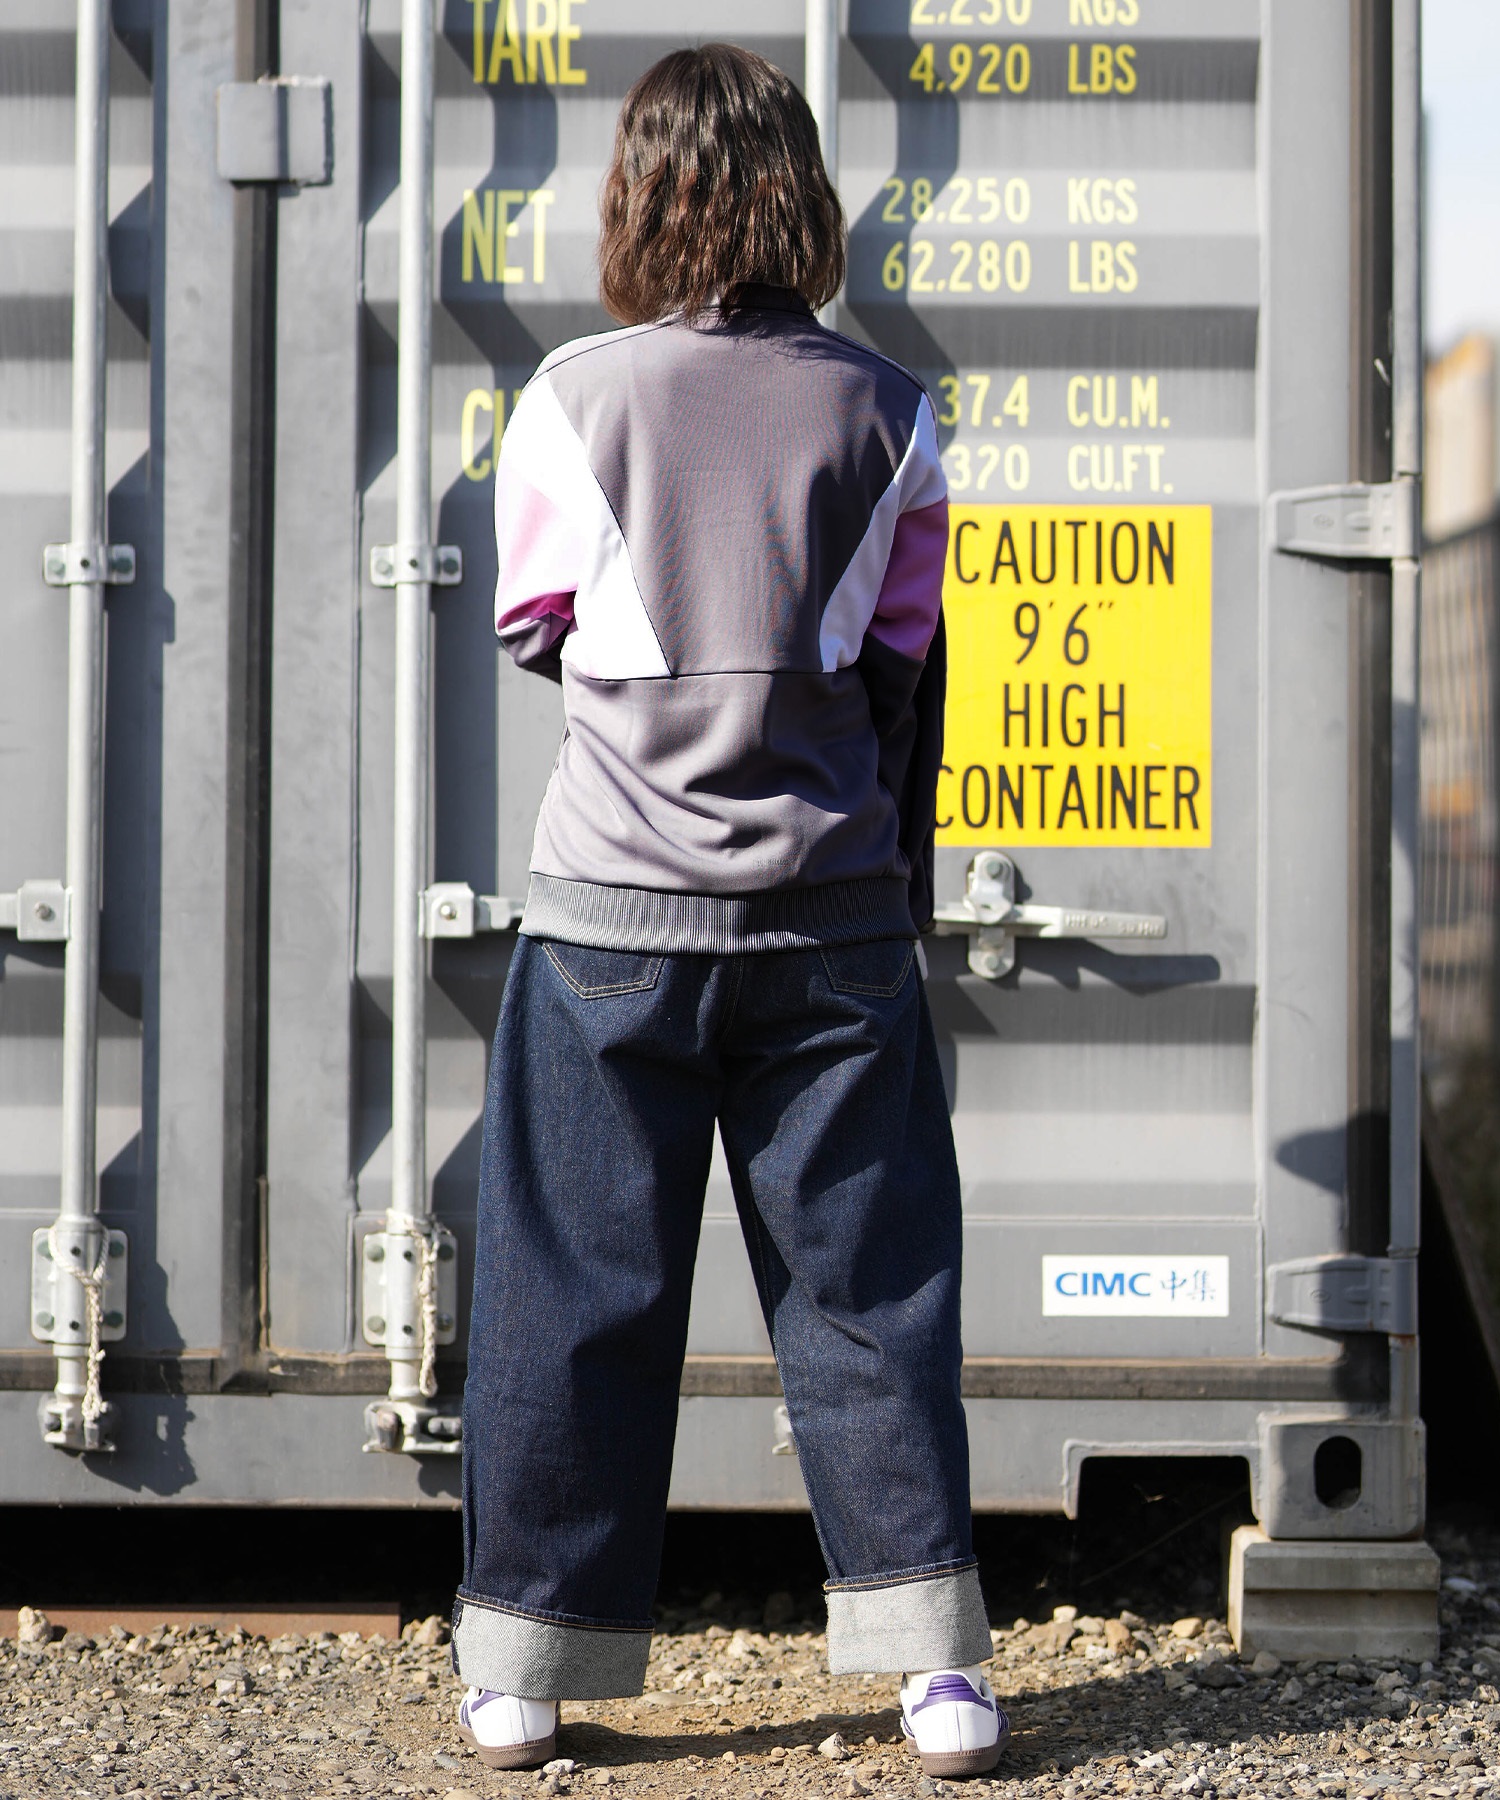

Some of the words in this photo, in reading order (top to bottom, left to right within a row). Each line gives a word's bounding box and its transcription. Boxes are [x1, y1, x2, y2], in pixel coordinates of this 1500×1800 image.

[1068, 0, 1140, 26] KGS
[469, 0, 588, 84] TARE
[1067, 43, 1137, 94] LBS
[1067, 177, 1139, 225] KGS
[461, 188, 554, 283] NET
[1068, 240, 1139, 293] LBS
[1067, 375, 1171, 428] CU.M.
[1067, 444, 1174, 494] CU.FT.
[955, 520, 1175, 585] CAUTION
[1003, 683, 1126, 748] HIGH
[1055, 1272, 1151, 1297] CIMC
[1160, 1269, 1216, 1302] 中集
